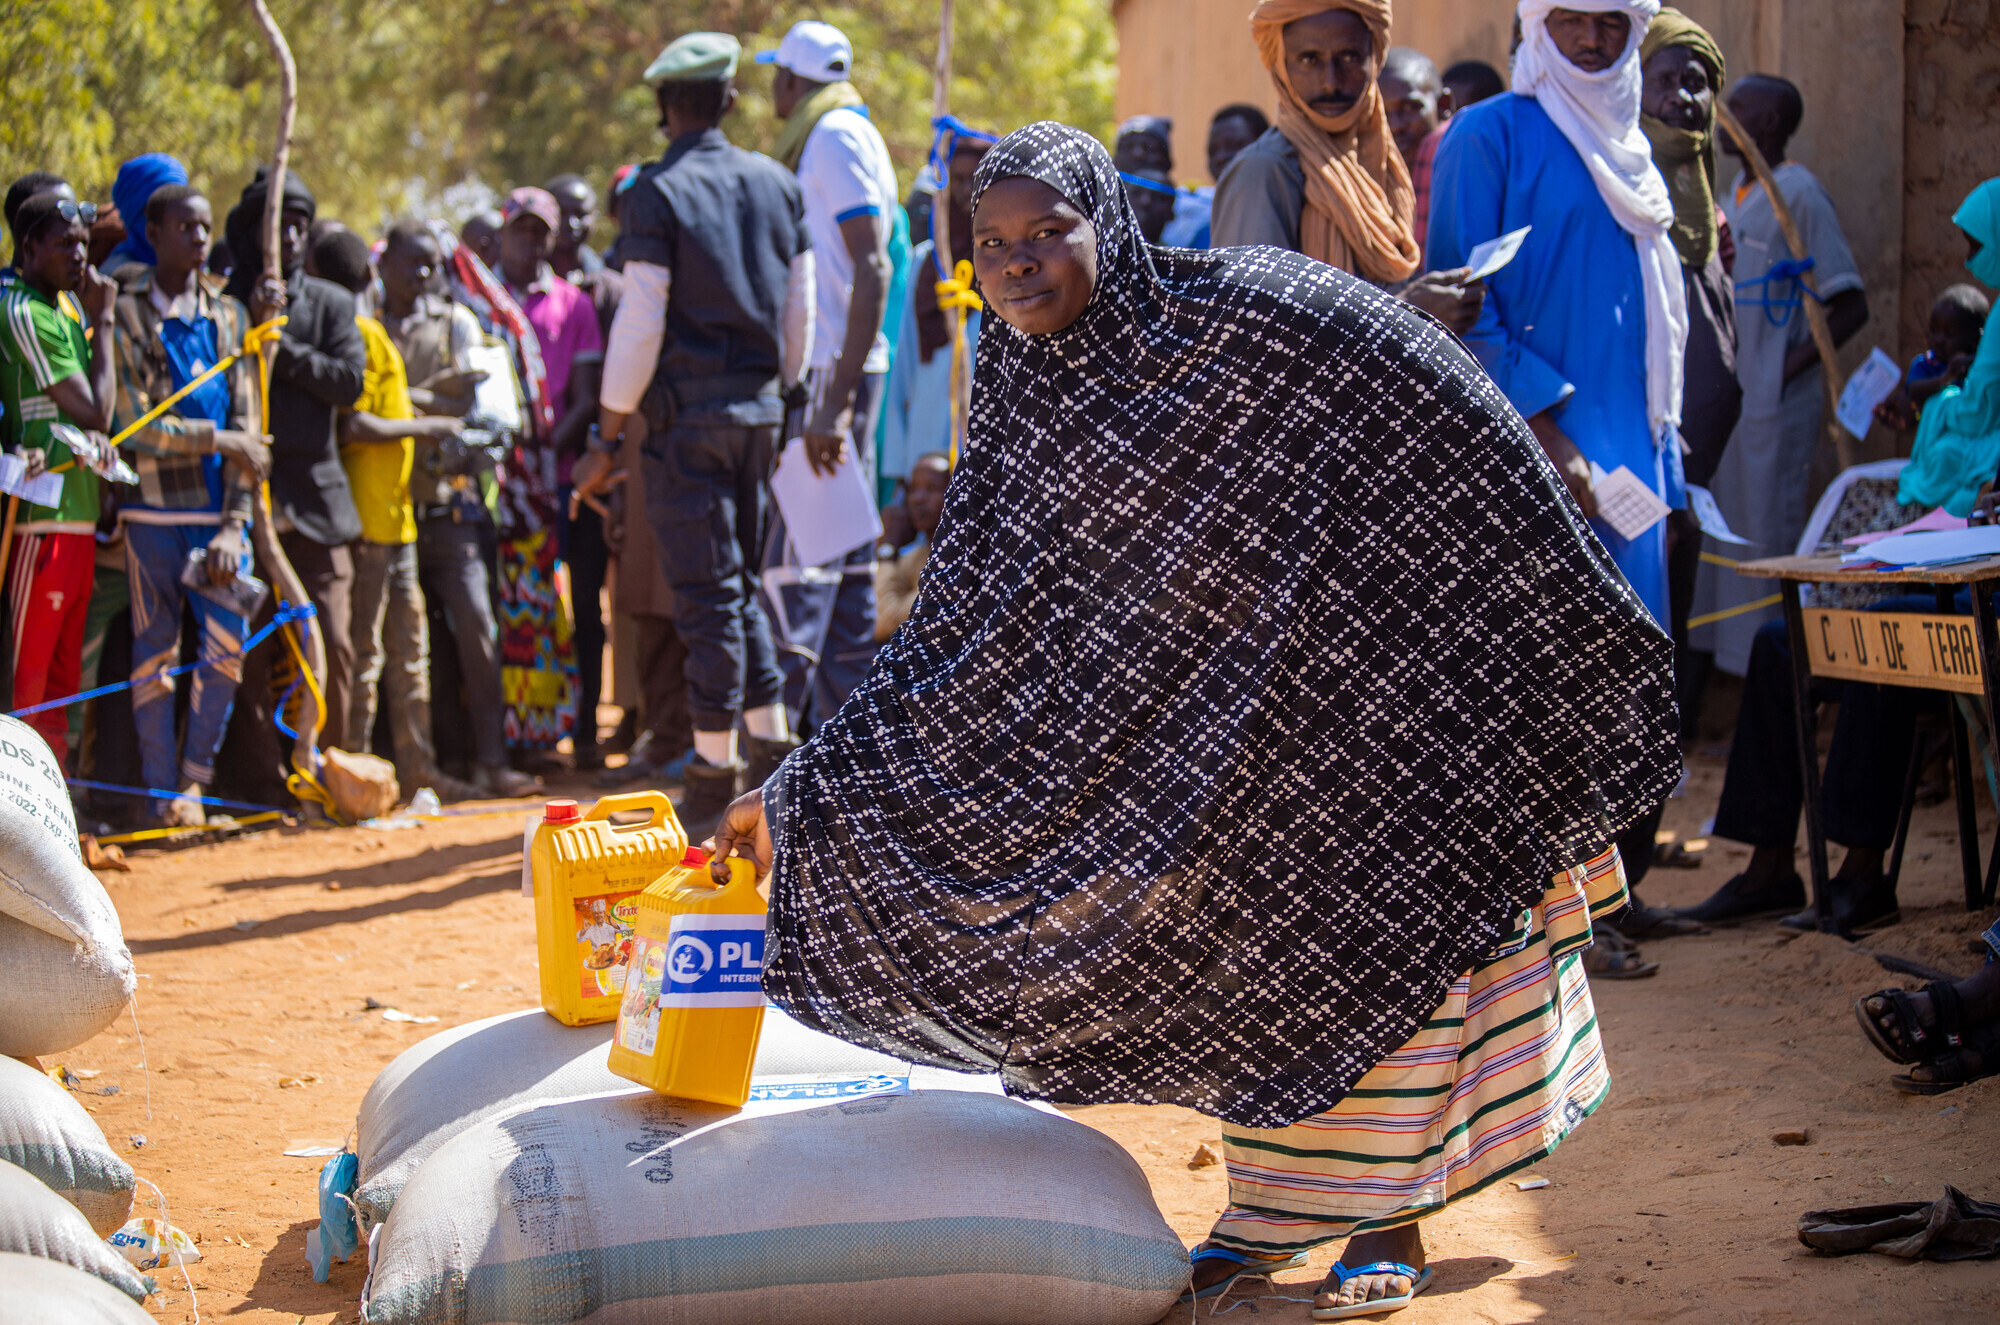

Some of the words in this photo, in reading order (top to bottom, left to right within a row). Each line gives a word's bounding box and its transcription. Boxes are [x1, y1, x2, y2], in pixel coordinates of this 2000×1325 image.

[1922, 622, 1978, 676] TERA
[0, 739, 35, 768] DS
[40, 760, 61, 789] 25
[720, 941, 764, 968] PL
[720, 974, 760, 983] INTERN
